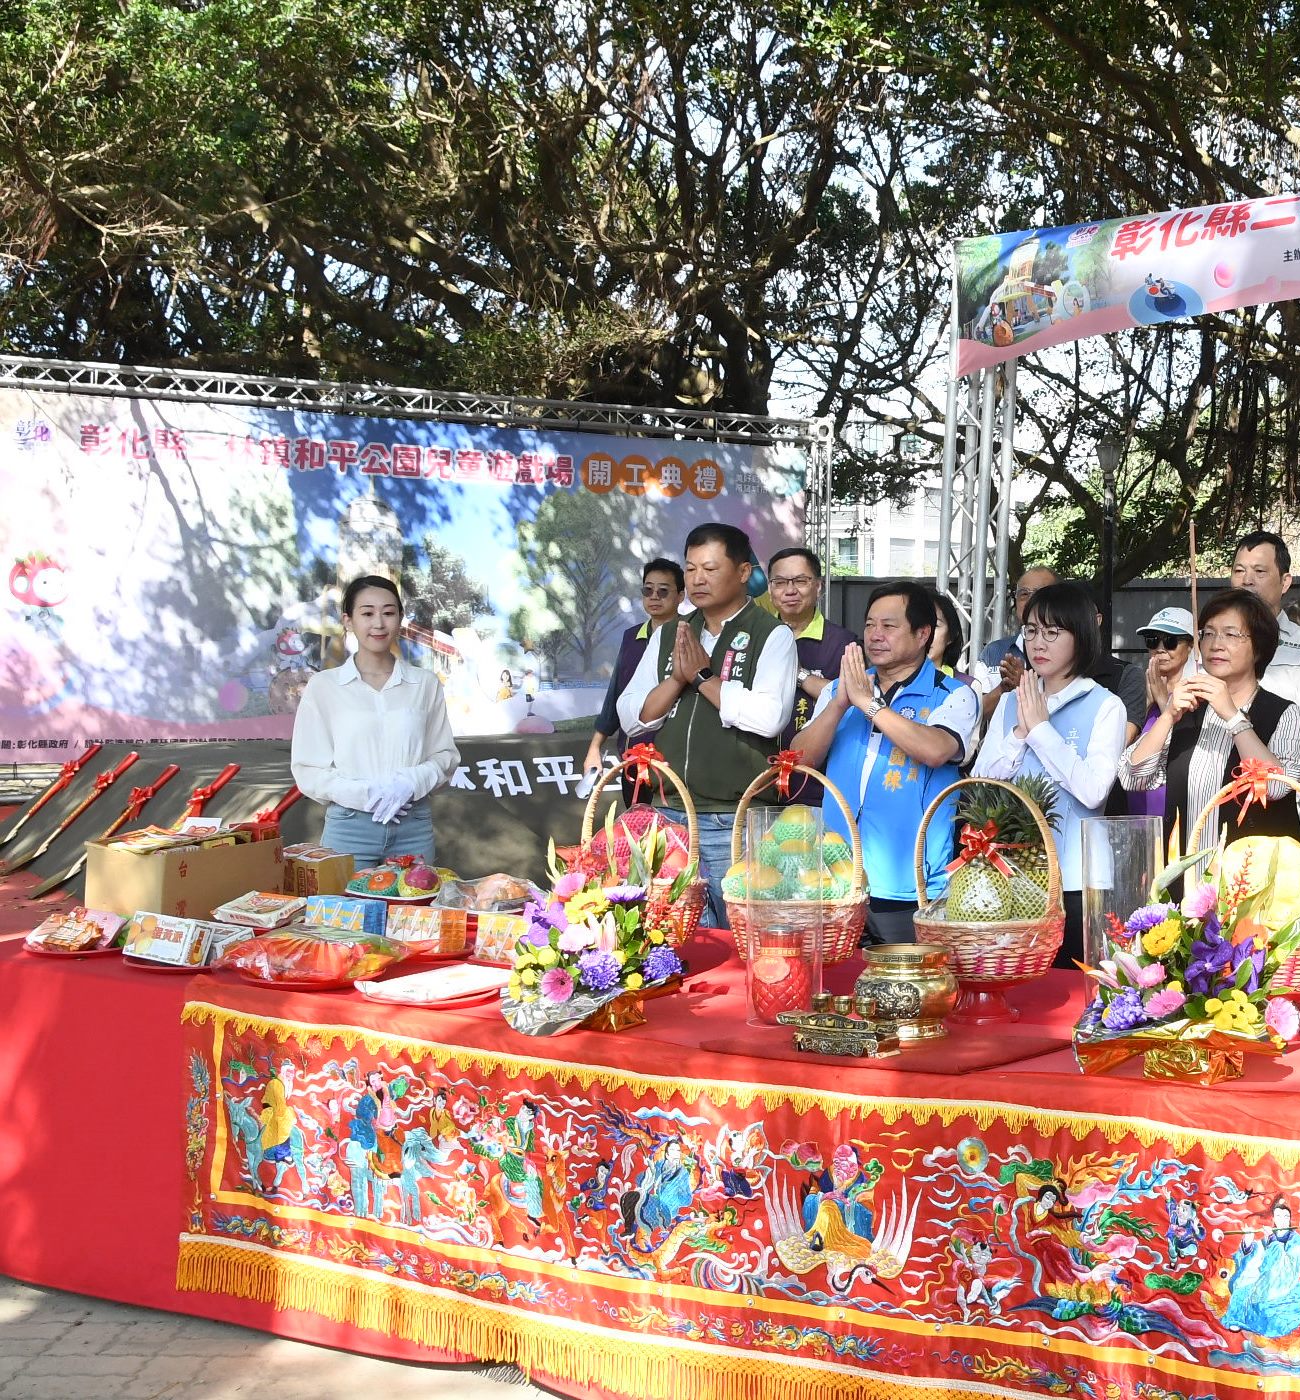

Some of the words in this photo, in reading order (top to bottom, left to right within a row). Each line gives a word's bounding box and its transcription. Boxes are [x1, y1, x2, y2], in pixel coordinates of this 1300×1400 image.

[79, 422, 574, 488] 彰化縣二林鎮和平公園兒童遊戲場
[587, 460, 719, 493] 開工典禮
